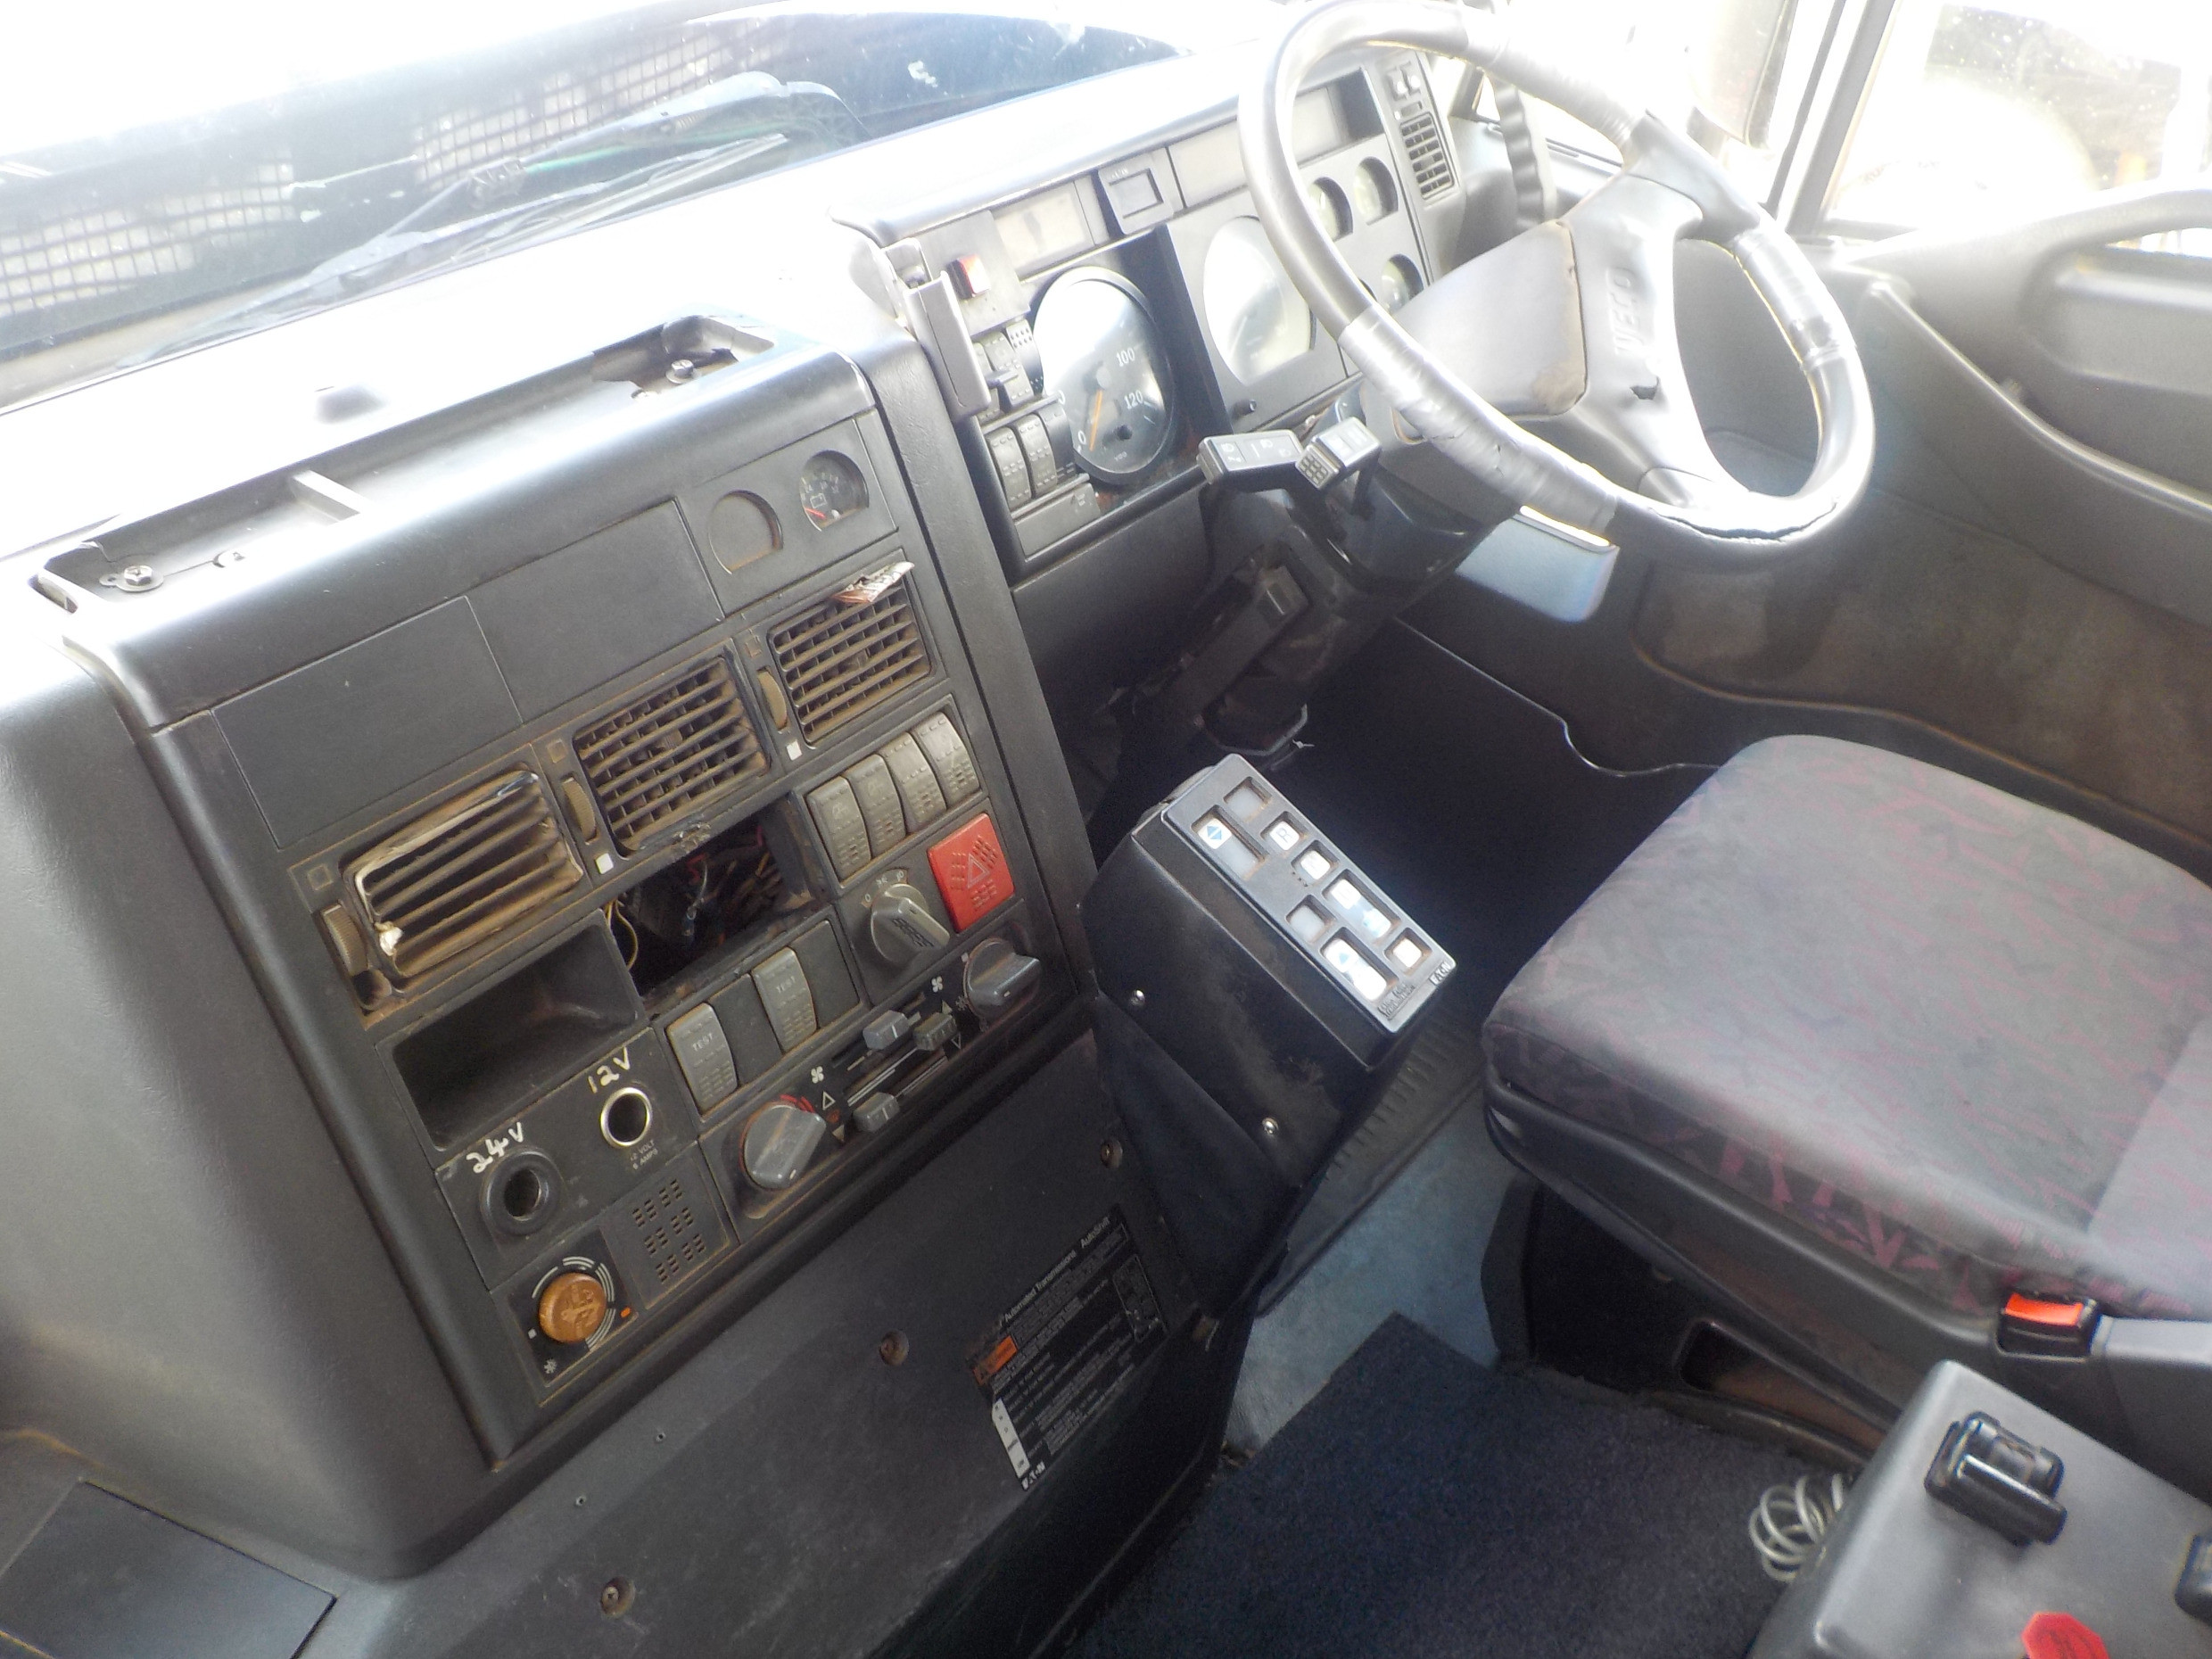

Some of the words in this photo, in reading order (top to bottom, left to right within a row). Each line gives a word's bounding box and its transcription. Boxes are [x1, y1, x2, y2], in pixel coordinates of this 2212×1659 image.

[1116, 347, 1135, 367] 100
[1124, 389, 1143, 409] 120
[1077, 430, 1086, 445] 0
[1275, 827, 1291, 844] R
[776, 975, 797, 995] TEST
[692, 1032, 714, 1052] TEST
[587, 1046, 631, 1094] 12V
[466, 1121, 524, 1174] 24V
[639, 1139, 656, 1154] VOLT
[640, 1148, 659, 1166] AMPS
[1004, 1287, 1038, 1323] Automated
[1036, 1250, 1077, 1292] Transmissions
[1080, 1216, 1110, 1249] AutoShift
